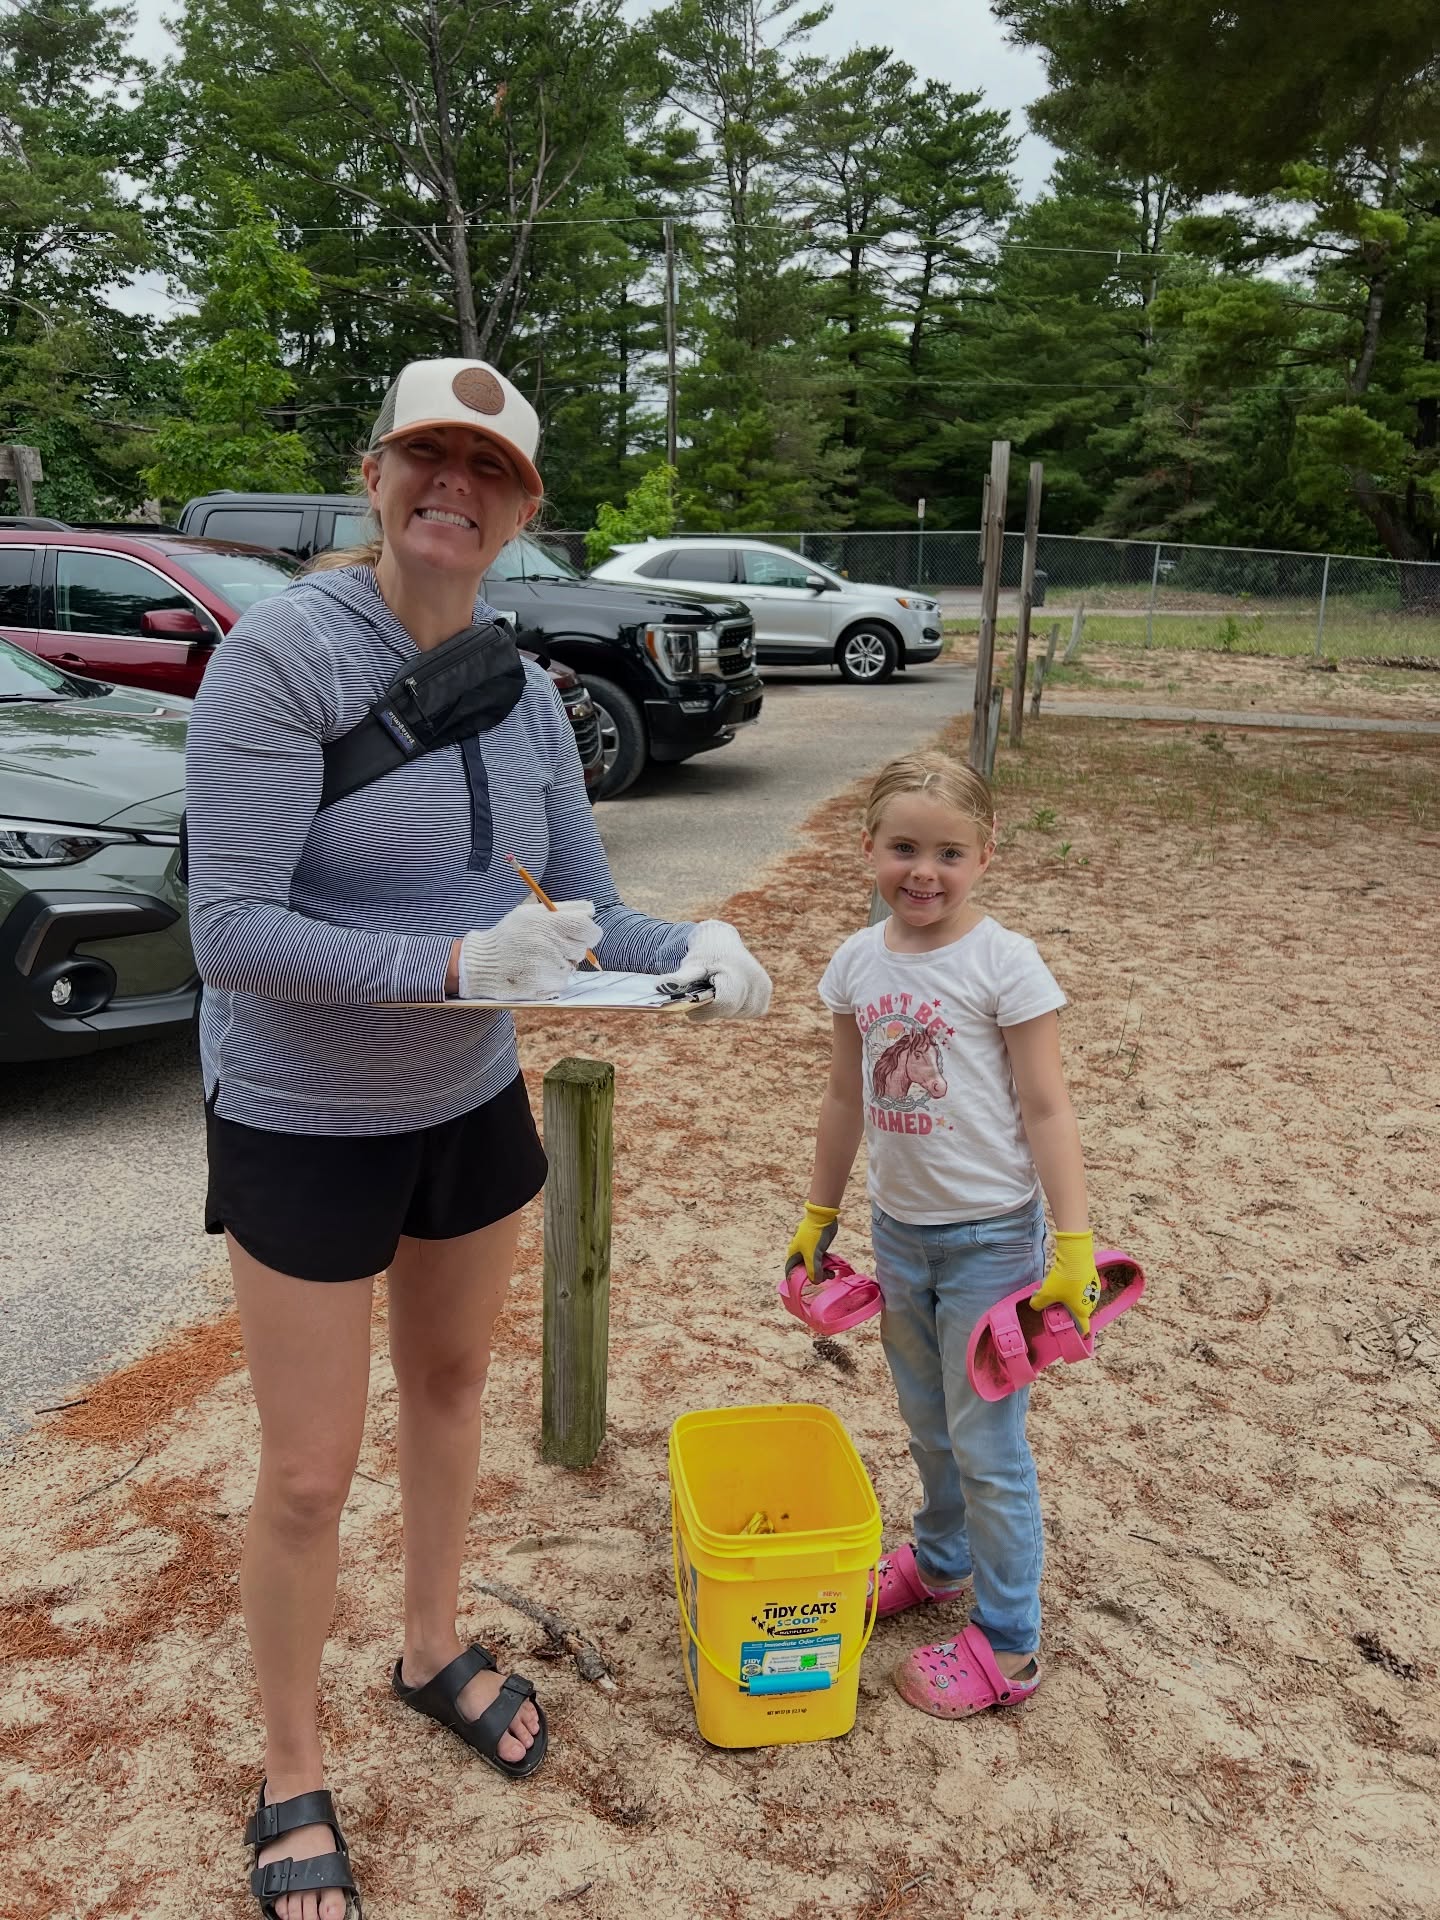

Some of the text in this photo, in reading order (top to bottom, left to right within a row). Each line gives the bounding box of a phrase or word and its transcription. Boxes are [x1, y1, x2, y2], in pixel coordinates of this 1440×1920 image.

[857, 992, 913, 1033] CAN'T
[869, 1105, 933, 1135] TAMED
[763, 1602, 837, 1620] TIDY CATS
[777, 1616, 819, 1628] SCOOP
